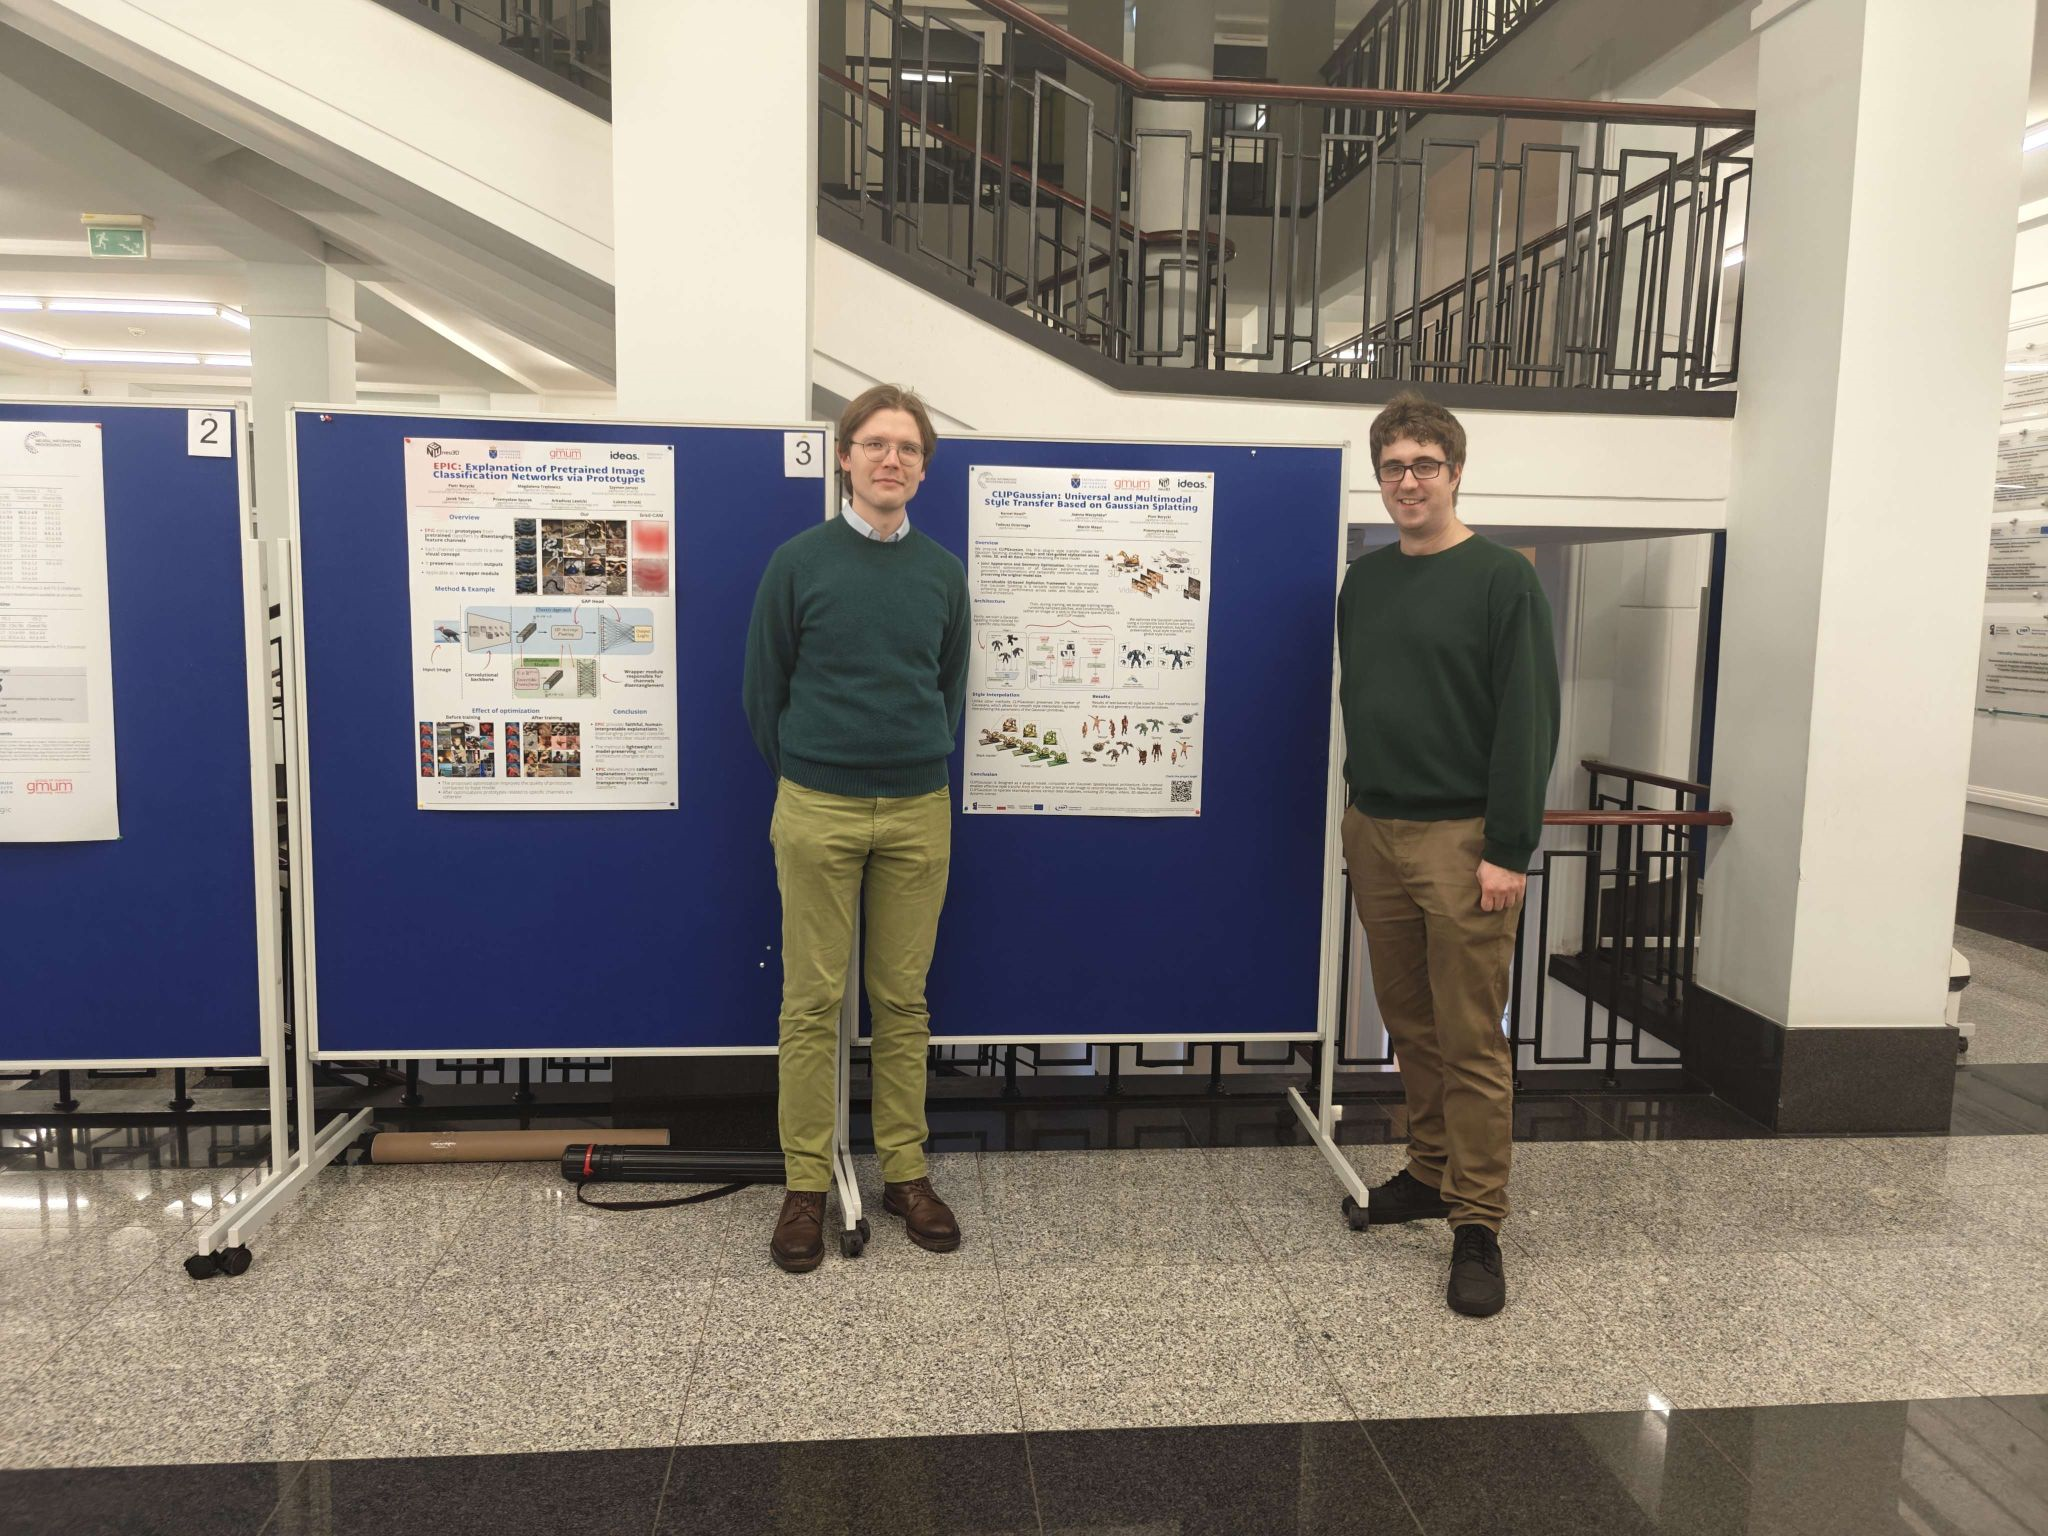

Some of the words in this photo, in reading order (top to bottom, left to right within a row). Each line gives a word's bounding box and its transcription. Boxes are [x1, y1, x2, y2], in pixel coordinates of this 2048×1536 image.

[200, 418, 218, 444] 2
[610, 451, 640, 460] ideas.
[796, 440, 812, 466] 3
[433, 462, 462, 470] EPIC:
[465, 463, 532, 472] Explanation
[536, 464, 547, 472] of
[550, 466, 608, 474] Pretrained
[612, 466, 645, 478] Image
[433, 470, 508, 480] Classification
[511, 472, 564, 482] Networks
[567, 474, 582, 482] via
[586, 475, 646, 485] Prototypes
[1178, 479, 1207, 489] ideas.
[992, 490, 1061, 500] CLIPGaussian:
[1064, 492, 1110, 501] Universal
[1114, 494, 1132, 502] and
[1136, 494, 1192, 503] Multimodal
[984, 498, 1012, 507] Style
[1013, 499, 1056, 508] Transfer
[1152, 503, 1198, 513] Splatting
[26, 782, 73, 794] gmum
